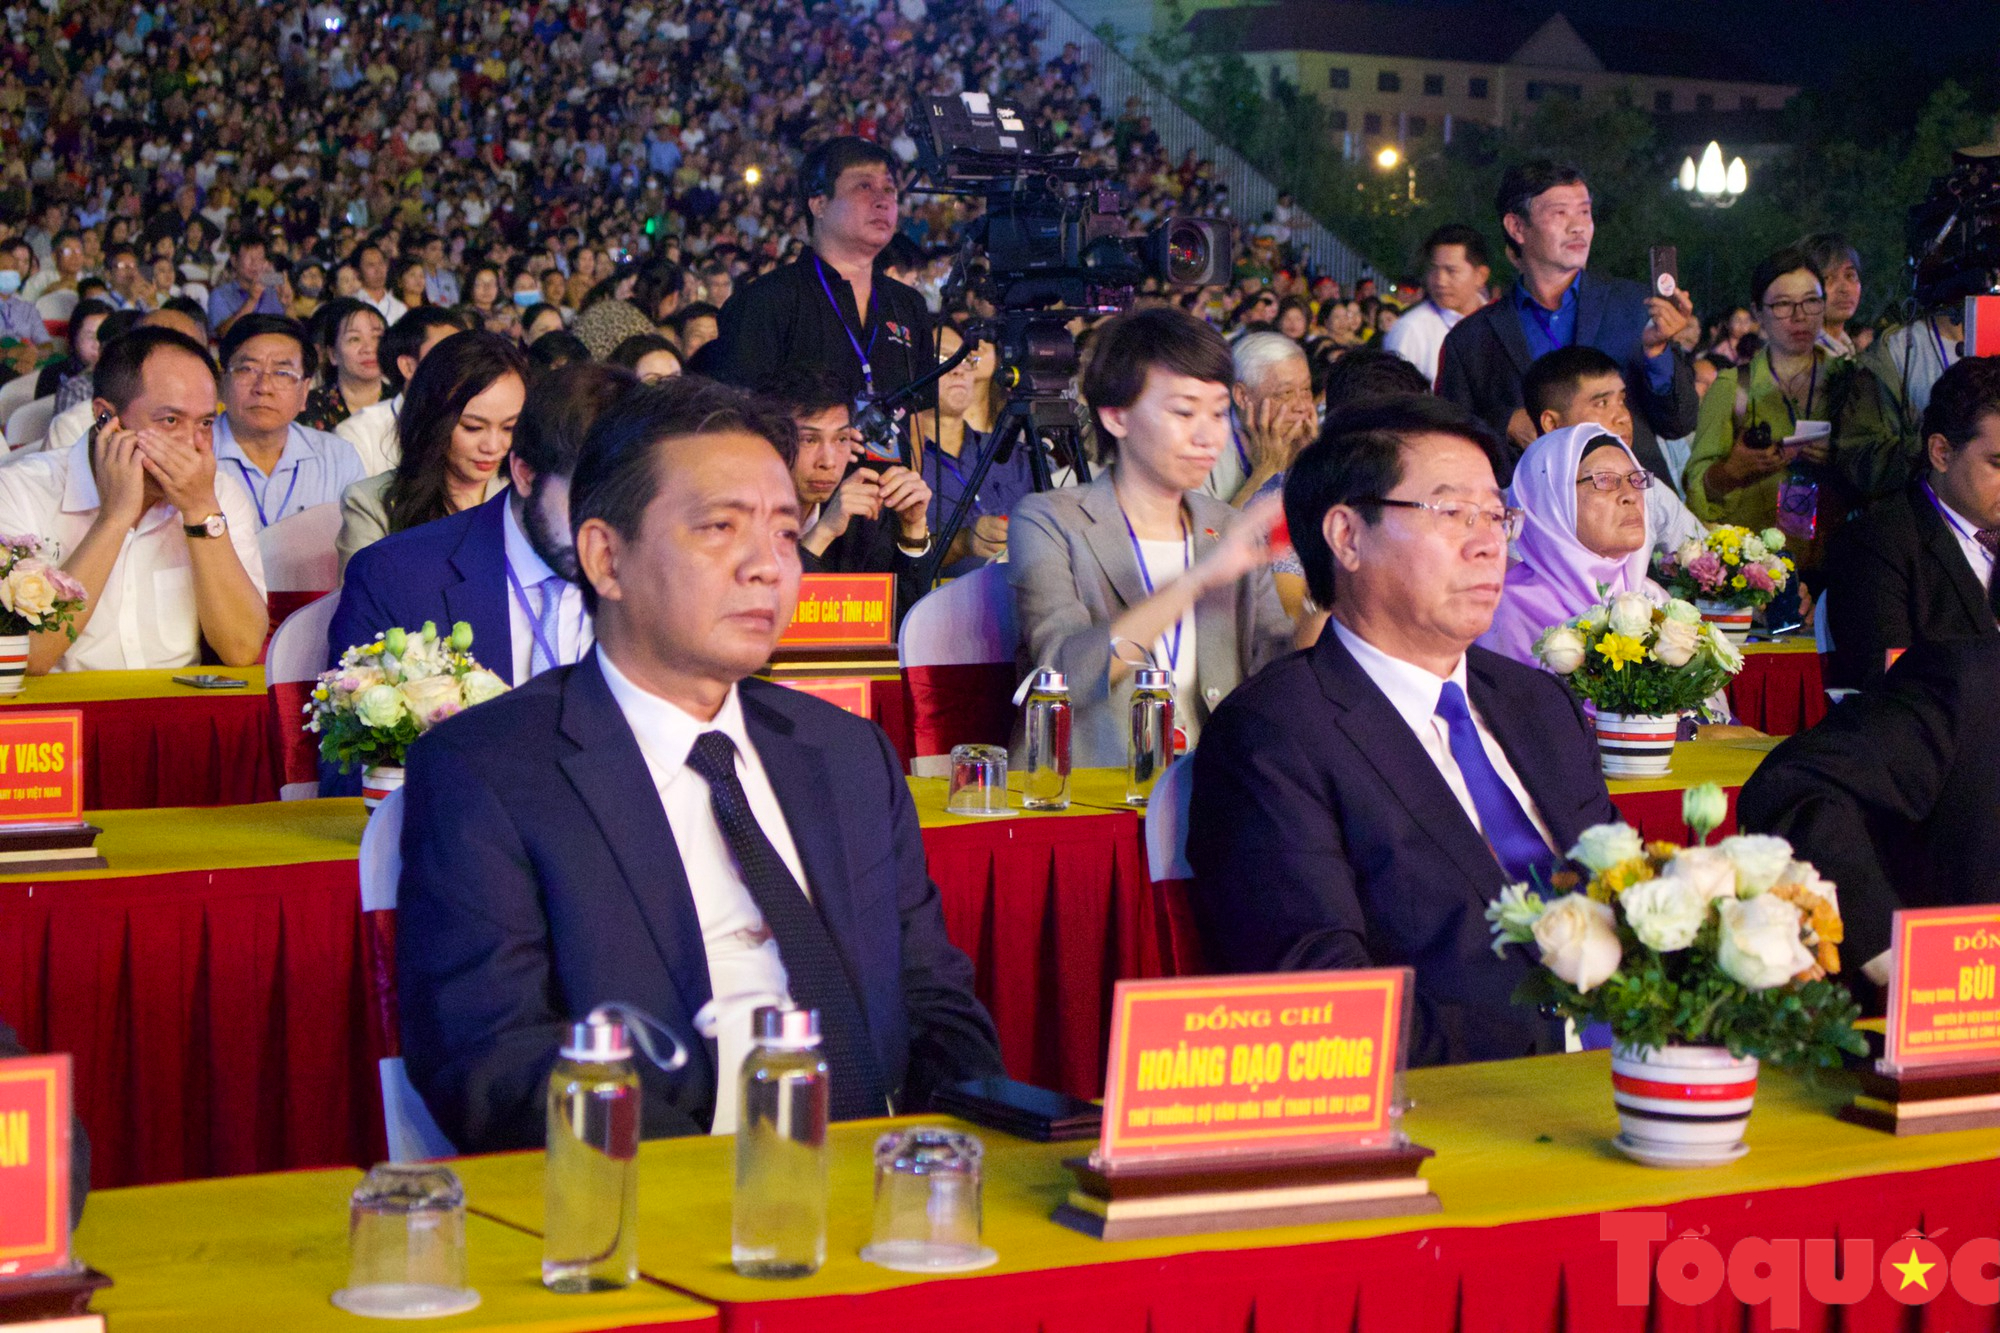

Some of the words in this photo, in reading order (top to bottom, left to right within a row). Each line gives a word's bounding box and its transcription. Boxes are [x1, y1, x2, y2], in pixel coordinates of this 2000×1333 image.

[822, 596, 840, 623] CÁC
[864, 600, 883, 627] BẠN
[15, 742, 65, 774] VASS
[1958, 957, 1996, 1002] BÙI
[1280, 1001, 1334, 1026] CHÍ
[1137, 1039, 1226, 1092] HOÀNG
[1230, 1042, 1284, 1093] ĐẠO
[1287, 1035, 1373, 1083] CƯƠNG
